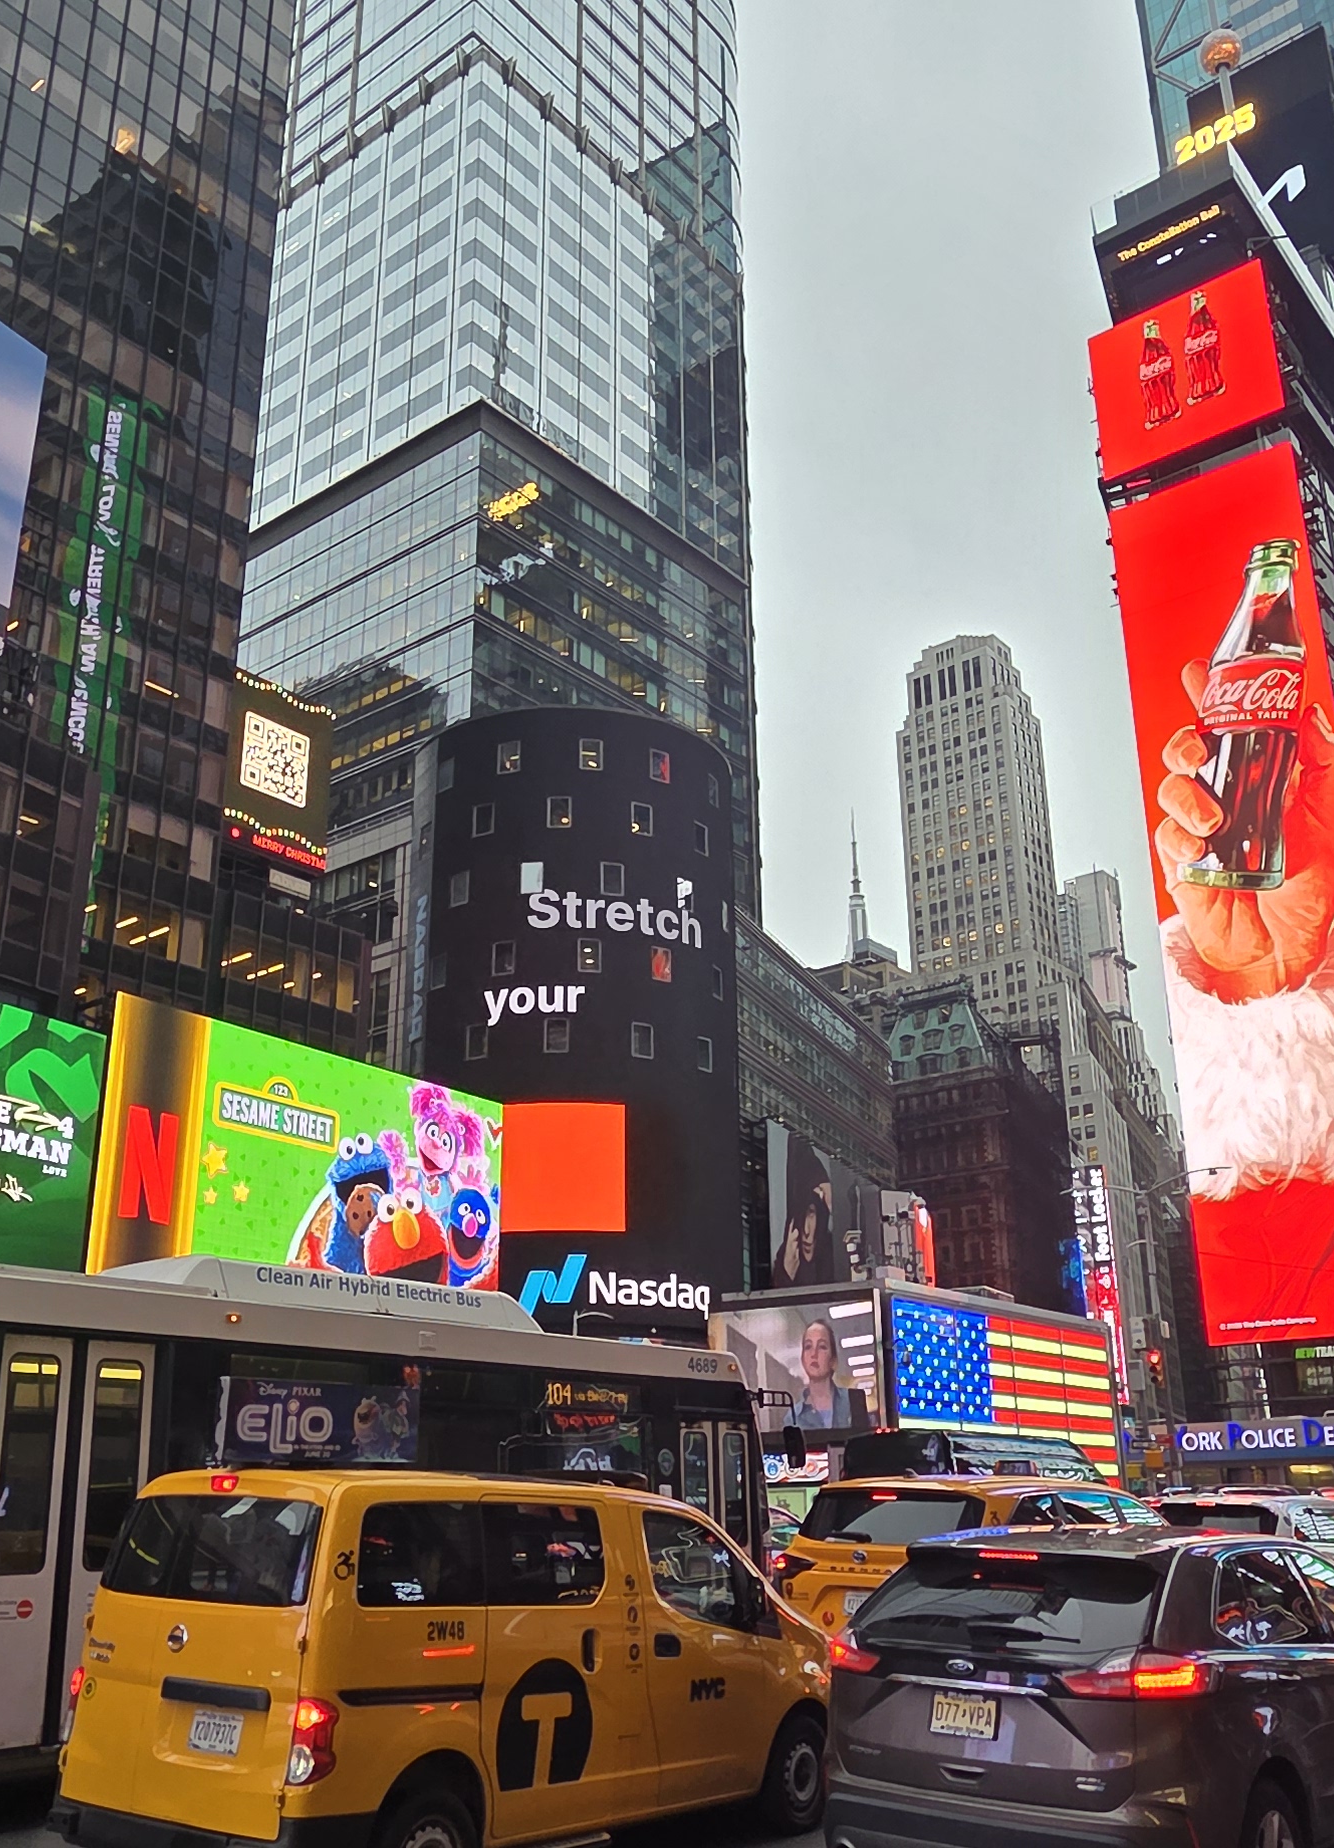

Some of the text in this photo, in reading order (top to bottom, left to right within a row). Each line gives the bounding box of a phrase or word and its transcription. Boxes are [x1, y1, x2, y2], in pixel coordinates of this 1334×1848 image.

[1174, 101, 1257, 166] 2025
[1117, 204, 1220, 261] The Constellation Ball
[1198, 668, 1303, 718] Coca-Cola
[1203, 710, 1289, 726] ORIGINAL TASTE
[252, 834, 285, 854] MERRY
[527, 889, 702, 949] Stretch
[408, 894, 429, 1043] NASDAQ
[483, 984, 586, 1027] your
[273, 1084, 289, 1097] 123
[56, 1116, 74, 1139] 4
[221, 1092, 334, 1143] SESAME STREET
[42, 1165, 68, 1178] LOVE
[117, 1105, 180, 1227] N
[1093, 1225, 1111, 1262] Foot
[256, 1266, 482, 1309] Clean Air Hybrid Electric Bus
[588, 1270, 711, 1321] Nasdaq
[686, 1356, 718, 1374] 4689
[257, 1381, 322, 1399] Disney PIXAR
[546, 1382, 572, 1406] 104
[1226, 1422, 1297, 1450] POLICE
[427, 1620, 465, 1641] 2W48
[689, 1677, 726, 1702] NYC
[968, 1706, 993, 1729] VPA
[520, 1691, 573, 1788] T
